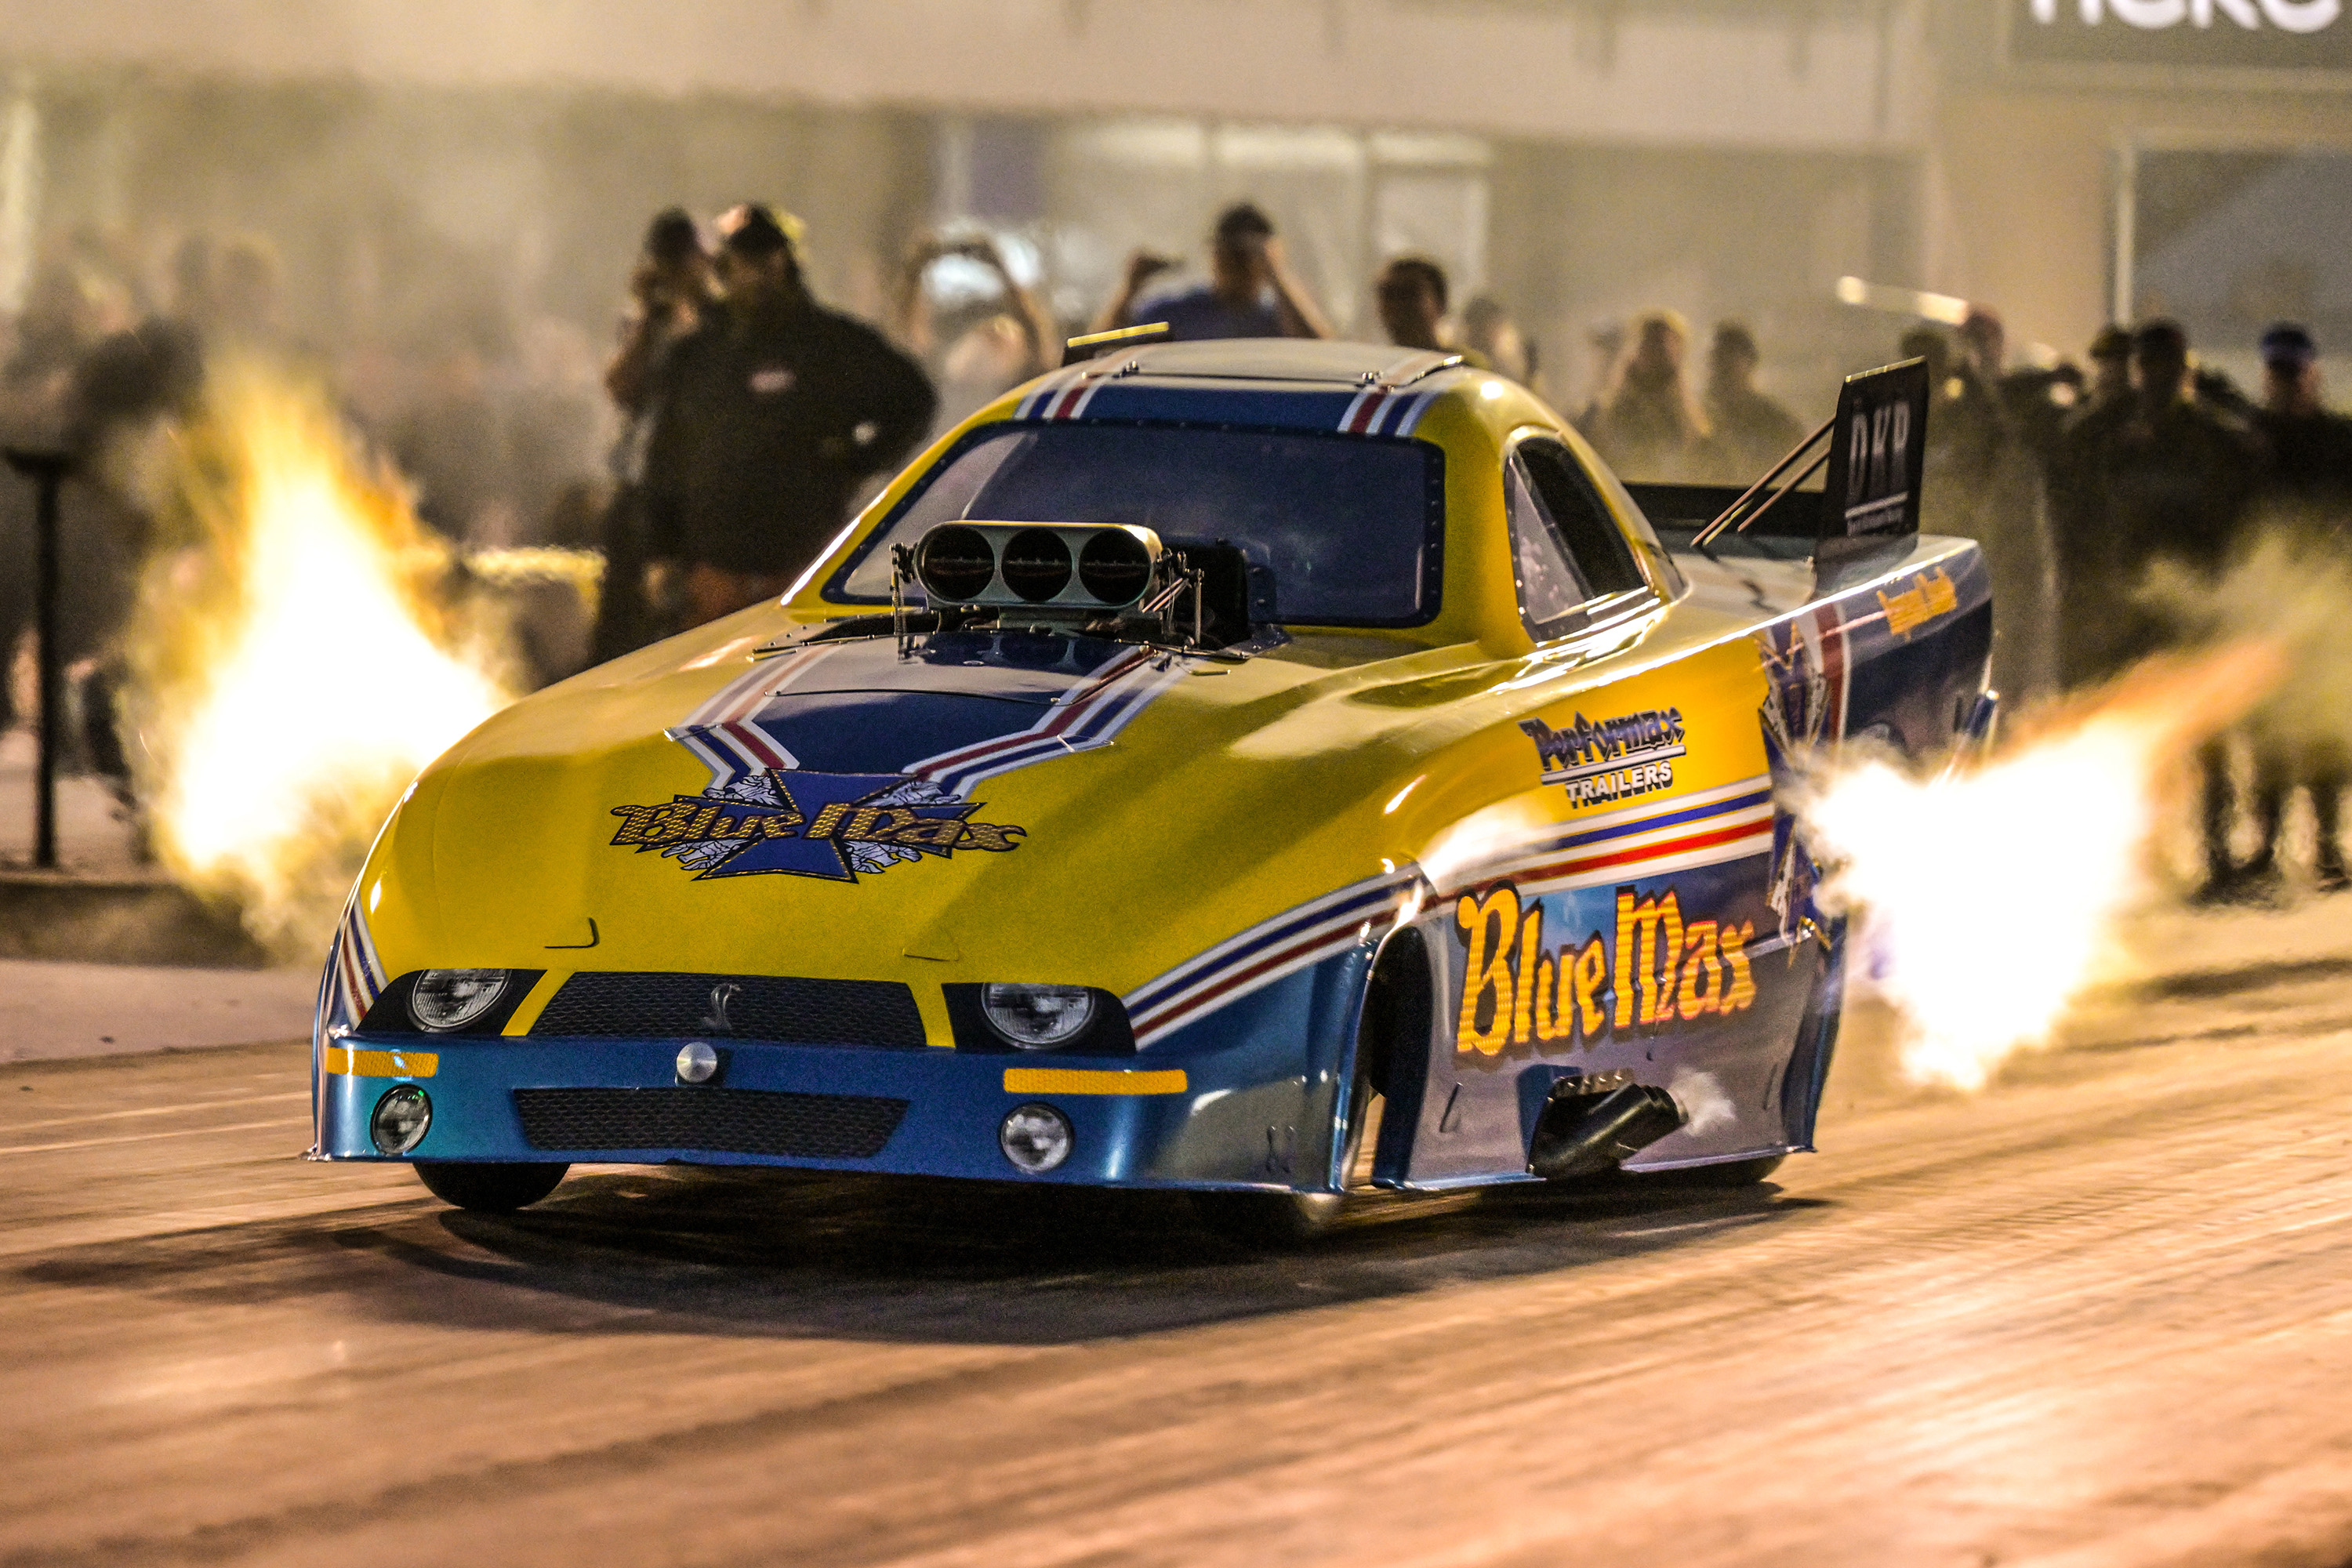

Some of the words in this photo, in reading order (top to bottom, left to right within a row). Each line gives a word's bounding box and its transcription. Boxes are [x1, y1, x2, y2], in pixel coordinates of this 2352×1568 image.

[1566, 760, 1674, 810] TRAILERS
[609, 803, 806, 845] Blue
[801, 803, 1028, 852] Max
[1456, 886, 1606, 1057] Blue
[1613, 888, 1758, 1029] Max
